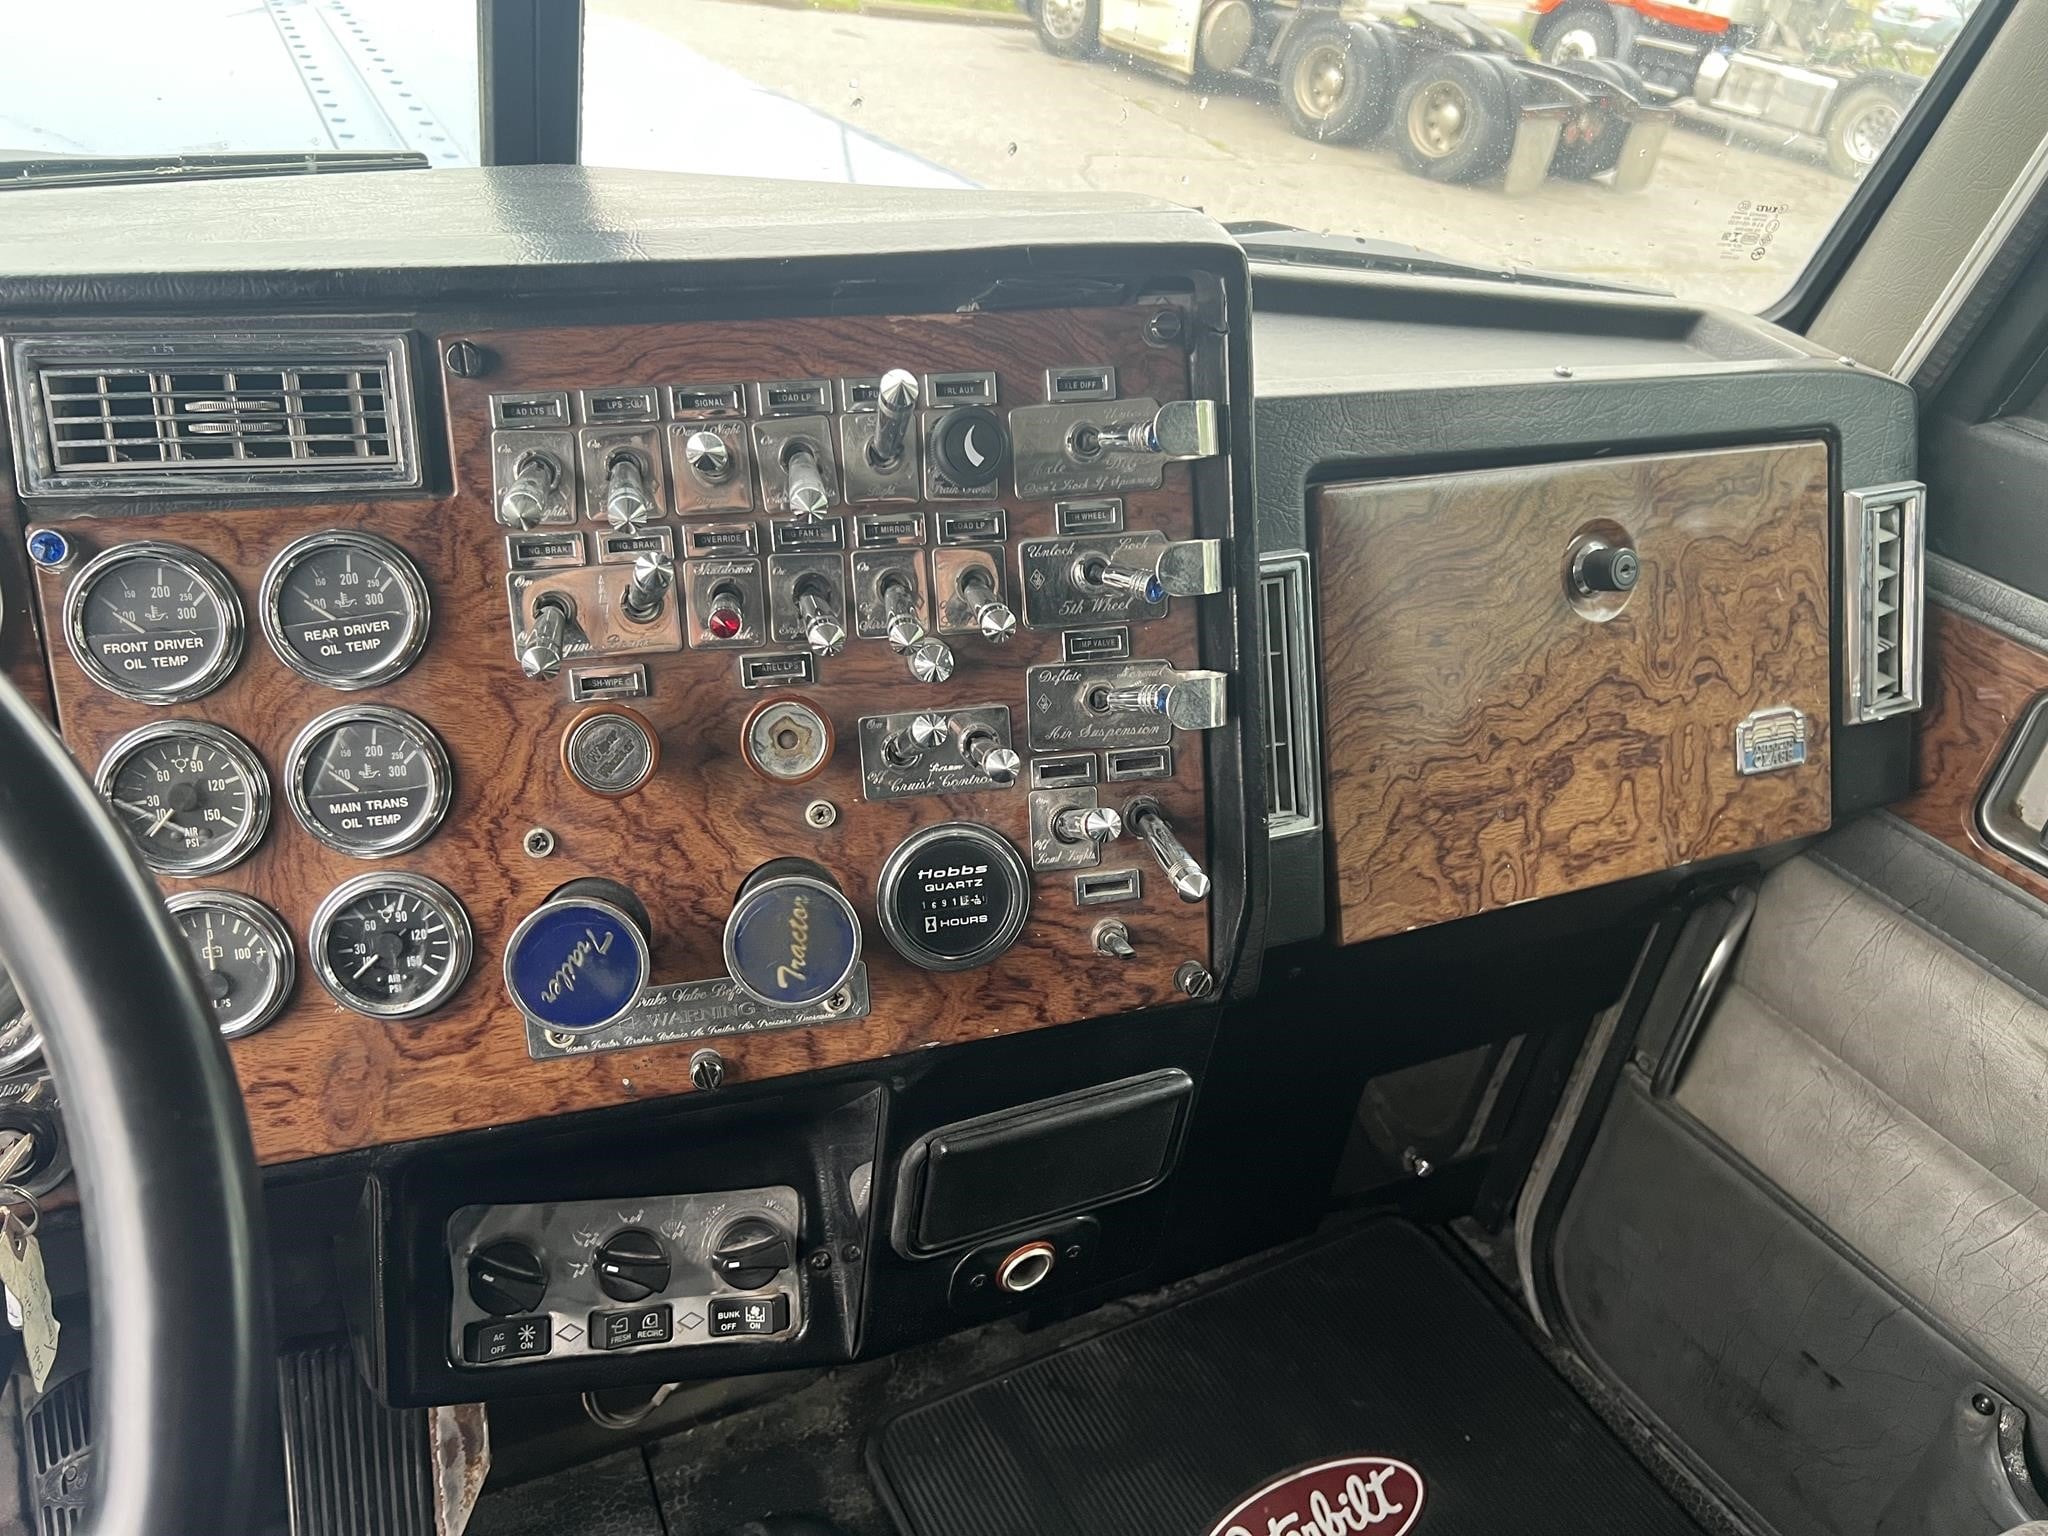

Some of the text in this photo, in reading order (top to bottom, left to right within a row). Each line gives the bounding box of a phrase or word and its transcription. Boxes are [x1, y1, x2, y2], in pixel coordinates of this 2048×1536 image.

[1080, 381, 1097, 389] DIFF
[694, 398, 724, 407] SIGNAL
[709, 423, 741, 437] Night
[1081, 511, 1106, 520] WHEEL
[881, 525, 911, 534] MIRROR
[545, 545, 570, 554] BRAK
[632, 541, 658, 549] BRAK
[1027, 536, 1150, 558] Unlock Lock
[693, 561, 755, 576] Shutdown
[315, 578, 326, 586] 150
[340, 573, 359, 586] 200
[367, 579, 380, 588] 250
[124, 591, 136, 599] 150
[151, 586, 170, 598] 200
[179, 593, 192, 602] 250
[365, 592, 384, 606] 300
[1091, 597, 1135, 614] Wheel
[177, 607, 197, 620] 300
[304, 620, 390, 642] REAR DRIVER
[103, 637, 204, 655] FRONT DRIVER
[320, 638, 381, 657] OIL TEMP
[124, 655, 189, 670] OIL TEMP
[1039, 669, 1082, 686] Deflate
[1079, 722, 1160, 742] Suspension
[365, 744, 383, 757] 200
[391, 752, 404, 760] 250
[190, 760, 204, 773] 90
[388, 765, 407, 777] 300
[156, 770, 171, 782] 60
[207, 778, 226, 792] 120
[890, 773, 993, 793] Cruise Contro
[147, 795, 160, 807] 30
[329, 797, 409, 815] MAIN TRANS
[204, 809, 221, 822] 150
[341, 814, 401, 830] OIL TEMP
[184, 826, 199, 838] AIR
[185, 838, 200, 849] PSI
[1034, 839, 1051, 851] Off
[918, 865, 988, 880] Hobbs
[925, 878, 984, 892] QUARTZ
[395, 911, 407, 922] 90
[940, 914, 988, 928] HOURS
[364, 919, 377, 931] 60
[411, 929, 427, 940] 120
[777, 895, 811, 989] Tractor
[234, 947, 251, 960] 100
[354, 943, 366, 955] 30
[406, 956, 422, 967] 150
[541, 928, 614, 1004] Trailer
[387, 974, 401, 983] AIR
[389, 984, 401, 994] PSI
[636, 992, 669, 1008] rake
[671, 986, 707, 1003] Valve
[647, 1001, 756, 1028] WARNING
[717, 1311, 740, 1320] BUNK
[721, 1323, 737, 1331] OFF
[749, 1322, 761, 1330] ON
[493, 1333, 505, 1342] AC
[610, 1333, 632, 1344] FRESH
[637, 1328, 664, 1338] RECIRC
[490, 1345, 506, 1355] OFF
[520, 1341, 534, 1350] ON
